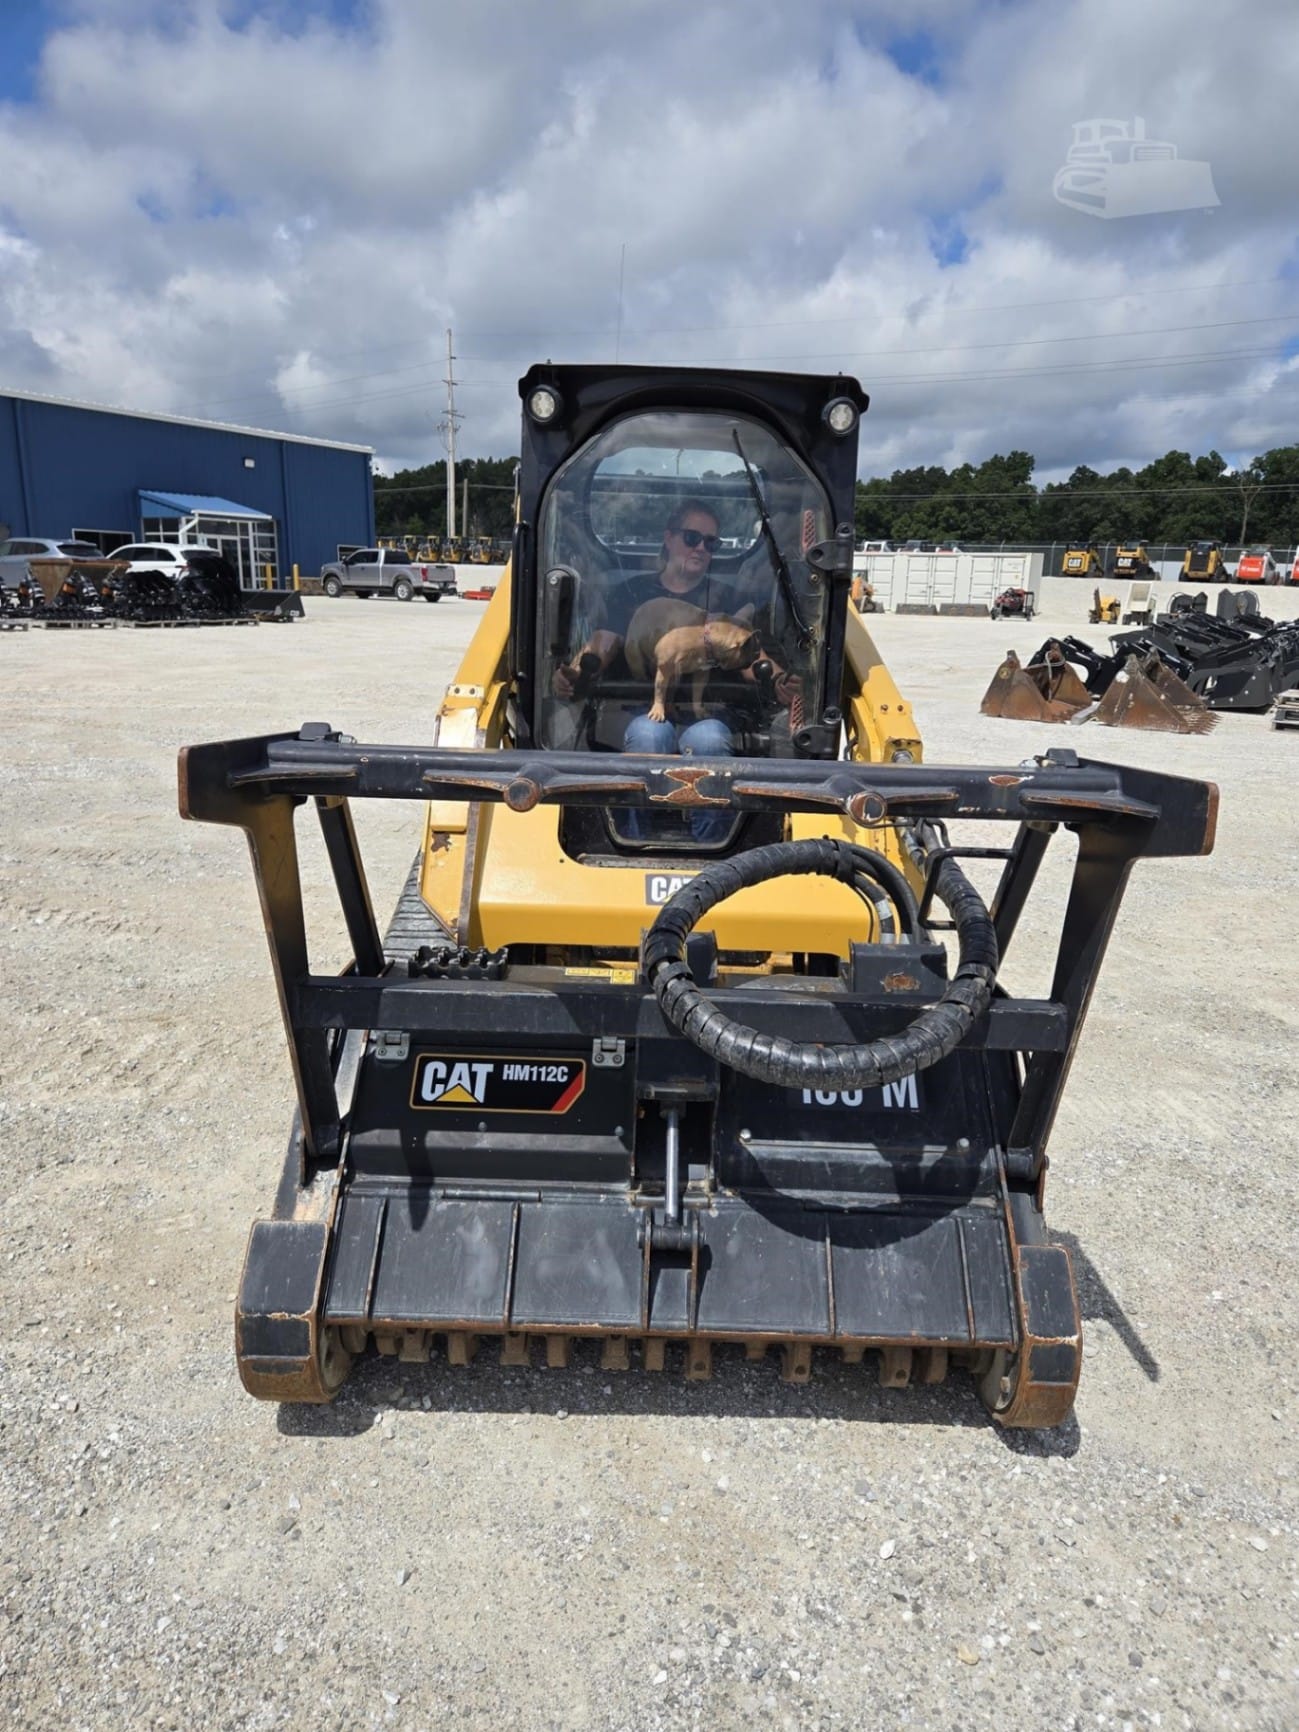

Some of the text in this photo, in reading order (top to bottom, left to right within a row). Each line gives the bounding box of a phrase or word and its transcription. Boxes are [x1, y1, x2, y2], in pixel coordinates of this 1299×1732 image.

[651, 876, 693, 902] CA
[421, 1061, 569, 1103] CAT HM112C
